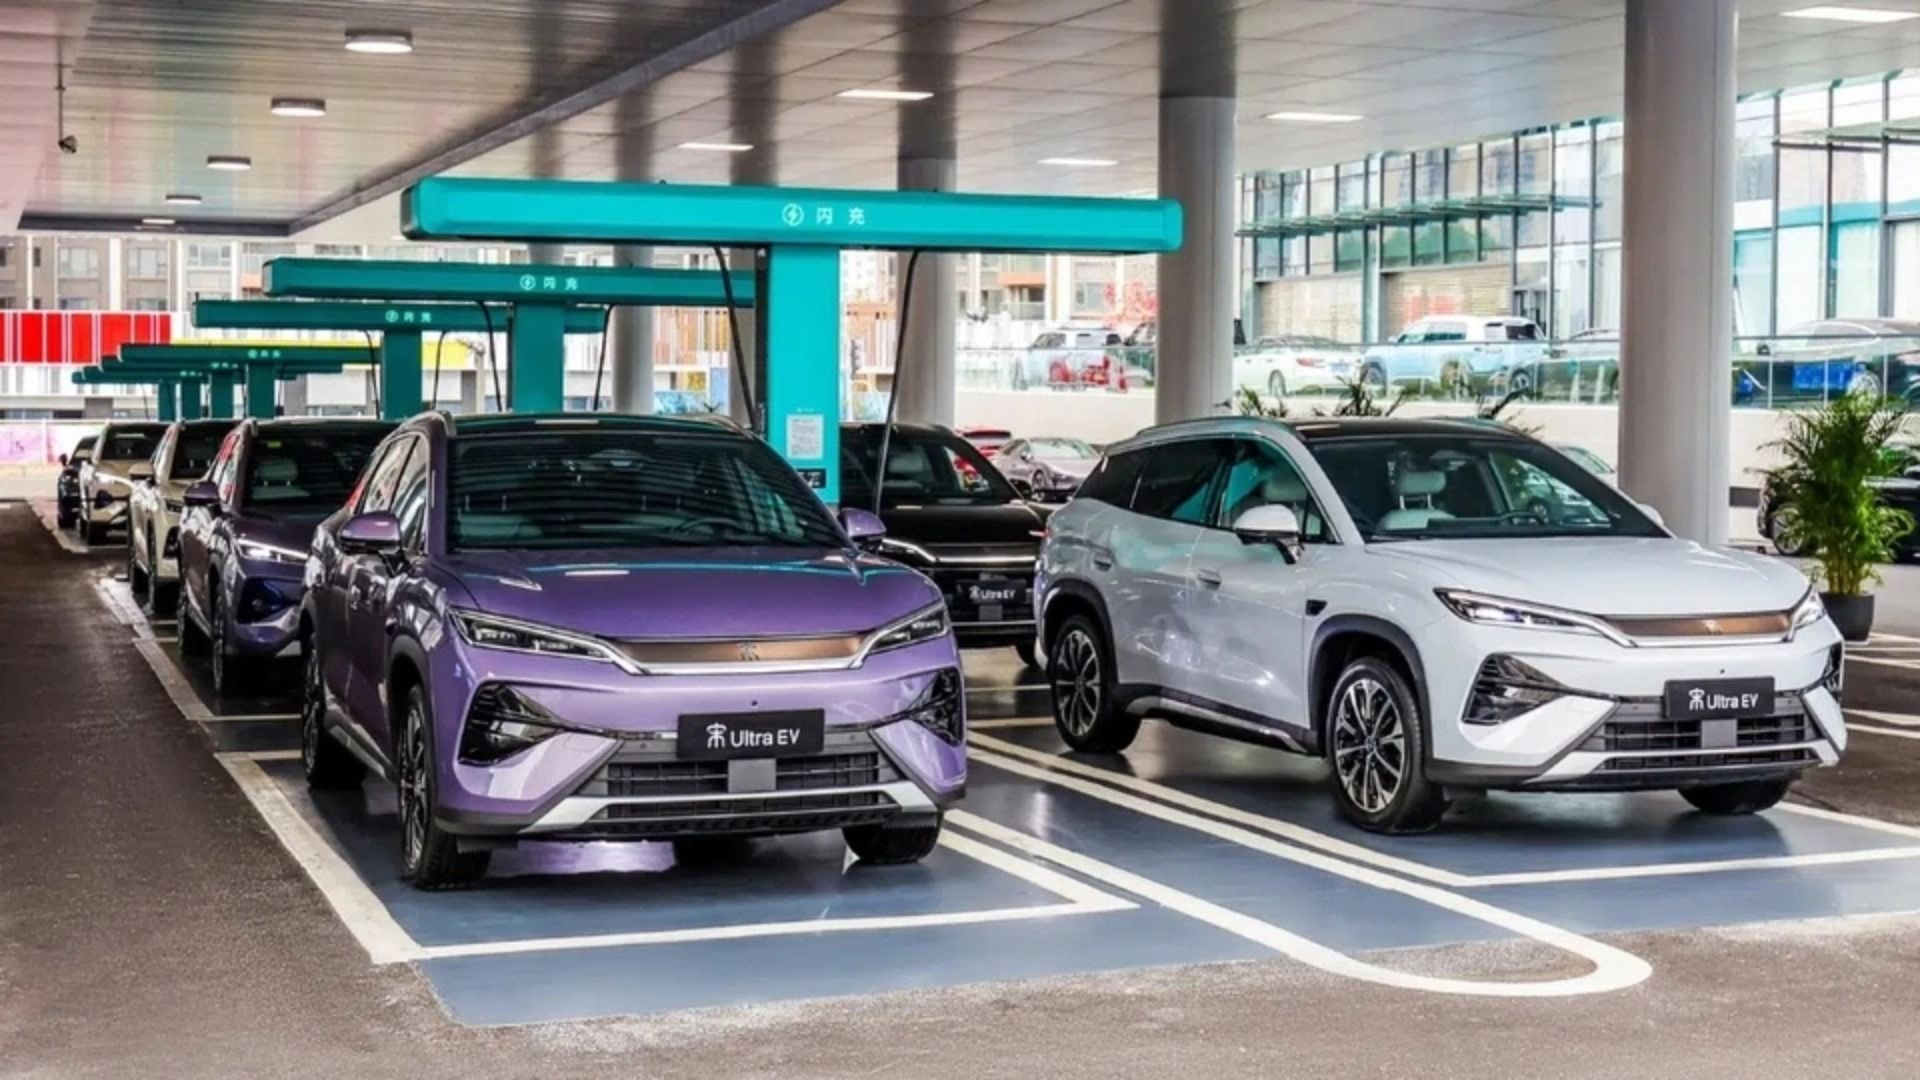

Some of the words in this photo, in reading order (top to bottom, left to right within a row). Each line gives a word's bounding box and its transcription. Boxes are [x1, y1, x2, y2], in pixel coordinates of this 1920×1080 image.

[816, 206, 866, 225] 闪充
[1706, 693, 1739, 710] Ultra
[1741, 692, 1759, 709] EV
[730, 729, 773, 748] Ultra
[777, 728, 800, 745] EV
